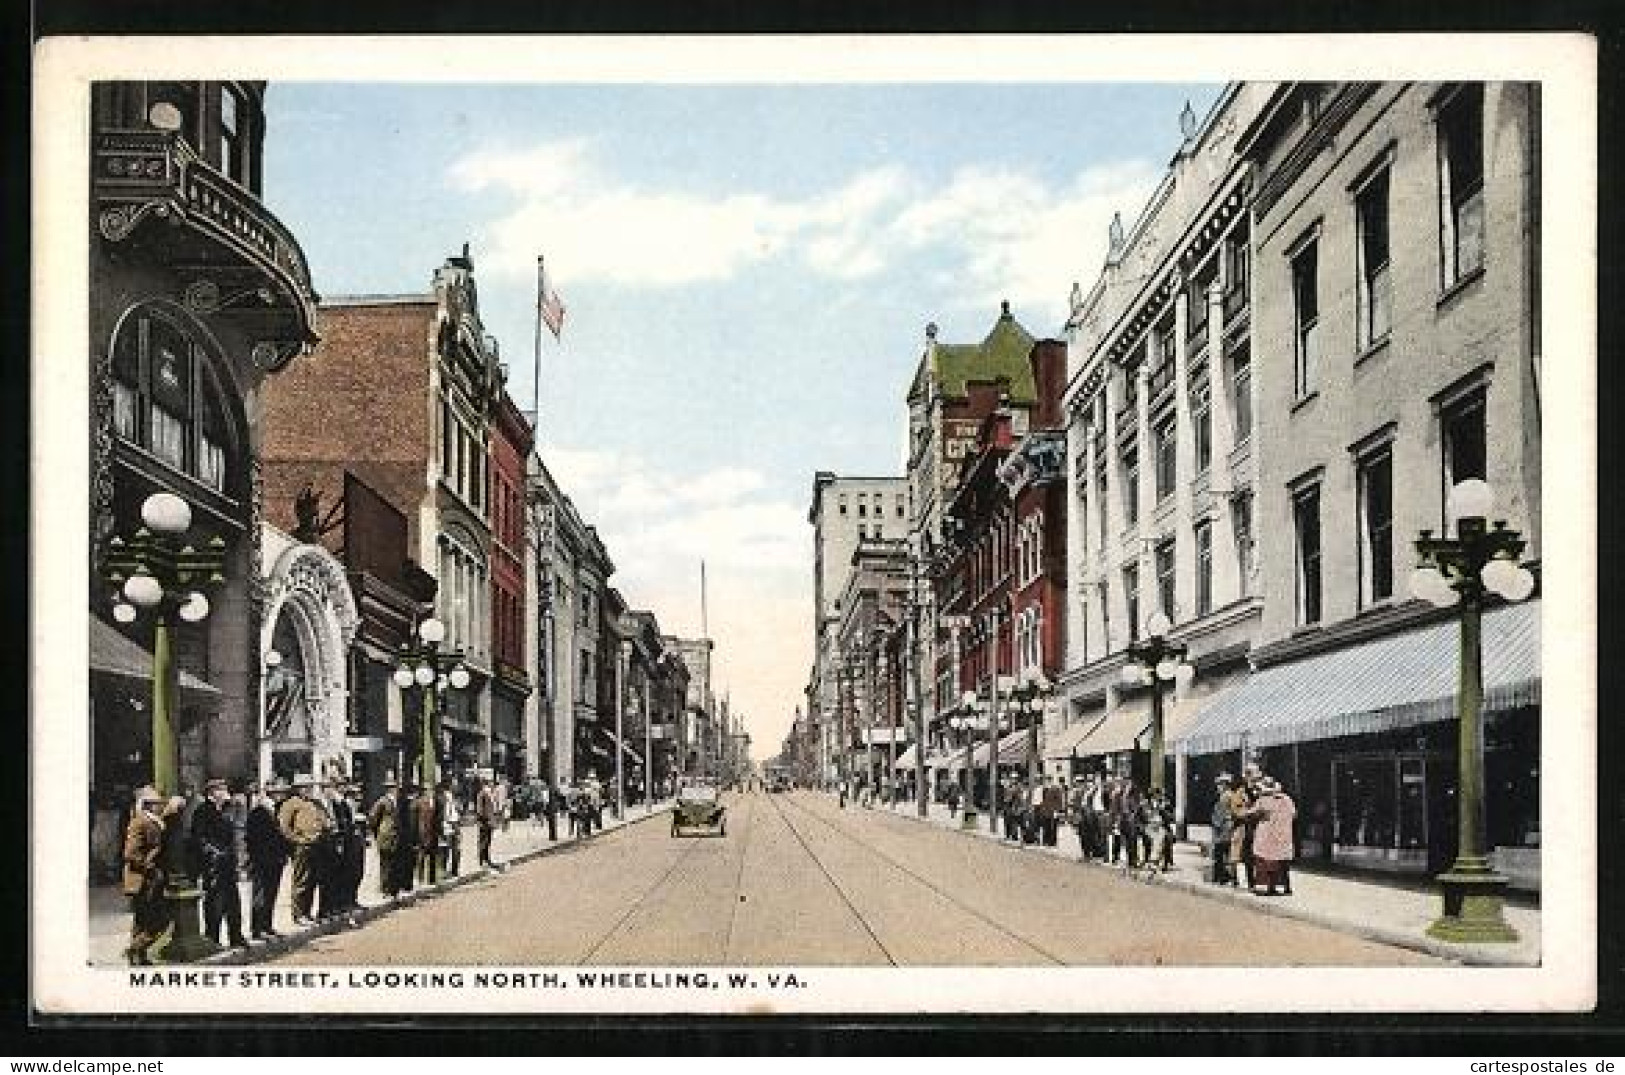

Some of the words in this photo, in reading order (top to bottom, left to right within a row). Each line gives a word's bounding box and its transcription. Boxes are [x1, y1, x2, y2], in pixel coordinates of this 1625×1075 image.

[129, 973, 231, 987] MARKET
[240, 973, 340, 989] STREET,
[348, 973, 464, 989] LOOKING
[476, 973, 567, 989] NORTH,
[577, 973, 719, 989] WHEELING,
[728, 974, 757, 988] W.
[767, 973, 808, 988] VA.
